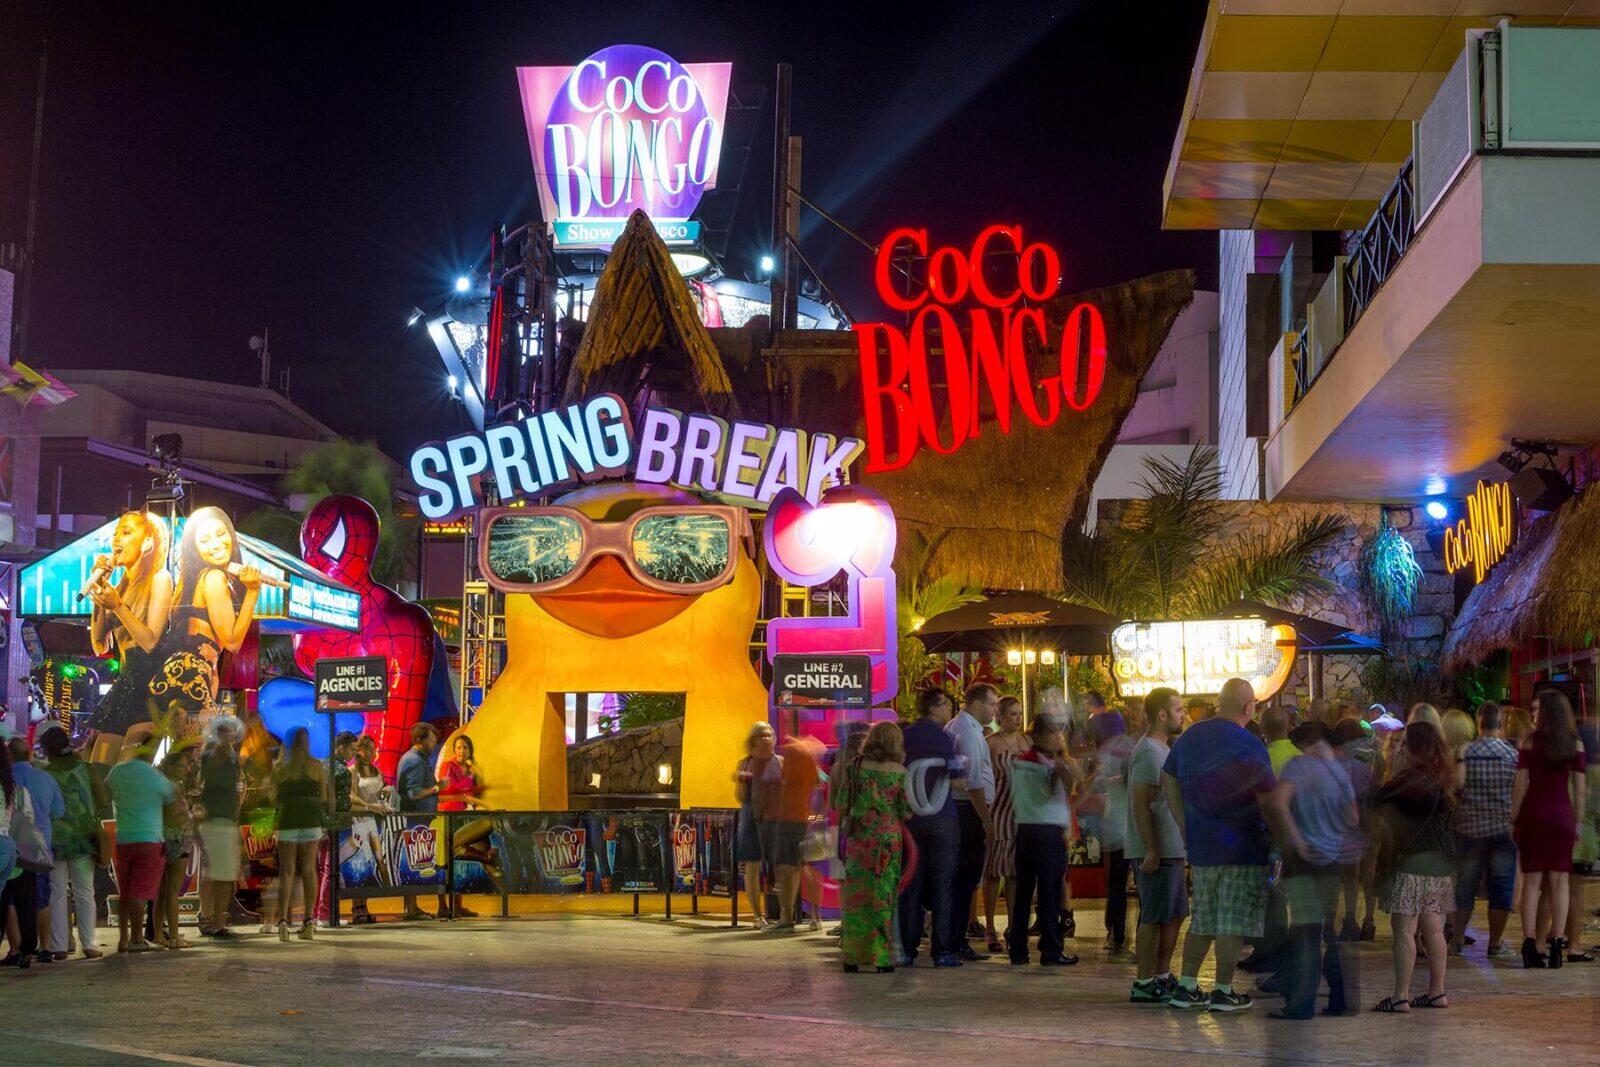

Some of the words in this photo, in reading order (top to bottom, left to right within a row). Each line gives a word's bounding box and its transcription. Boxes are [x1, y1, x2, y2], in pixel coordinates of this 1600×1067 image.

[547, 109, 719, 220] BONGO
[567, 224, 613, 240] Show
[851, 303, 1108, 475] BONGO
[410, 395, 631, 520] SPRING
[635, 409, 861, 508] BREAK
[336, 665, 356, 676] LINE
[356, 665, 366, 675] #1
[803, 662, 829, 673] LINE
[830, 662, 844, 673] #2
[319, 676, 383, 693] AGENCIES
[783, 674, 862, 689] GENERAL
[543, 843, 585, 872] BONGO
